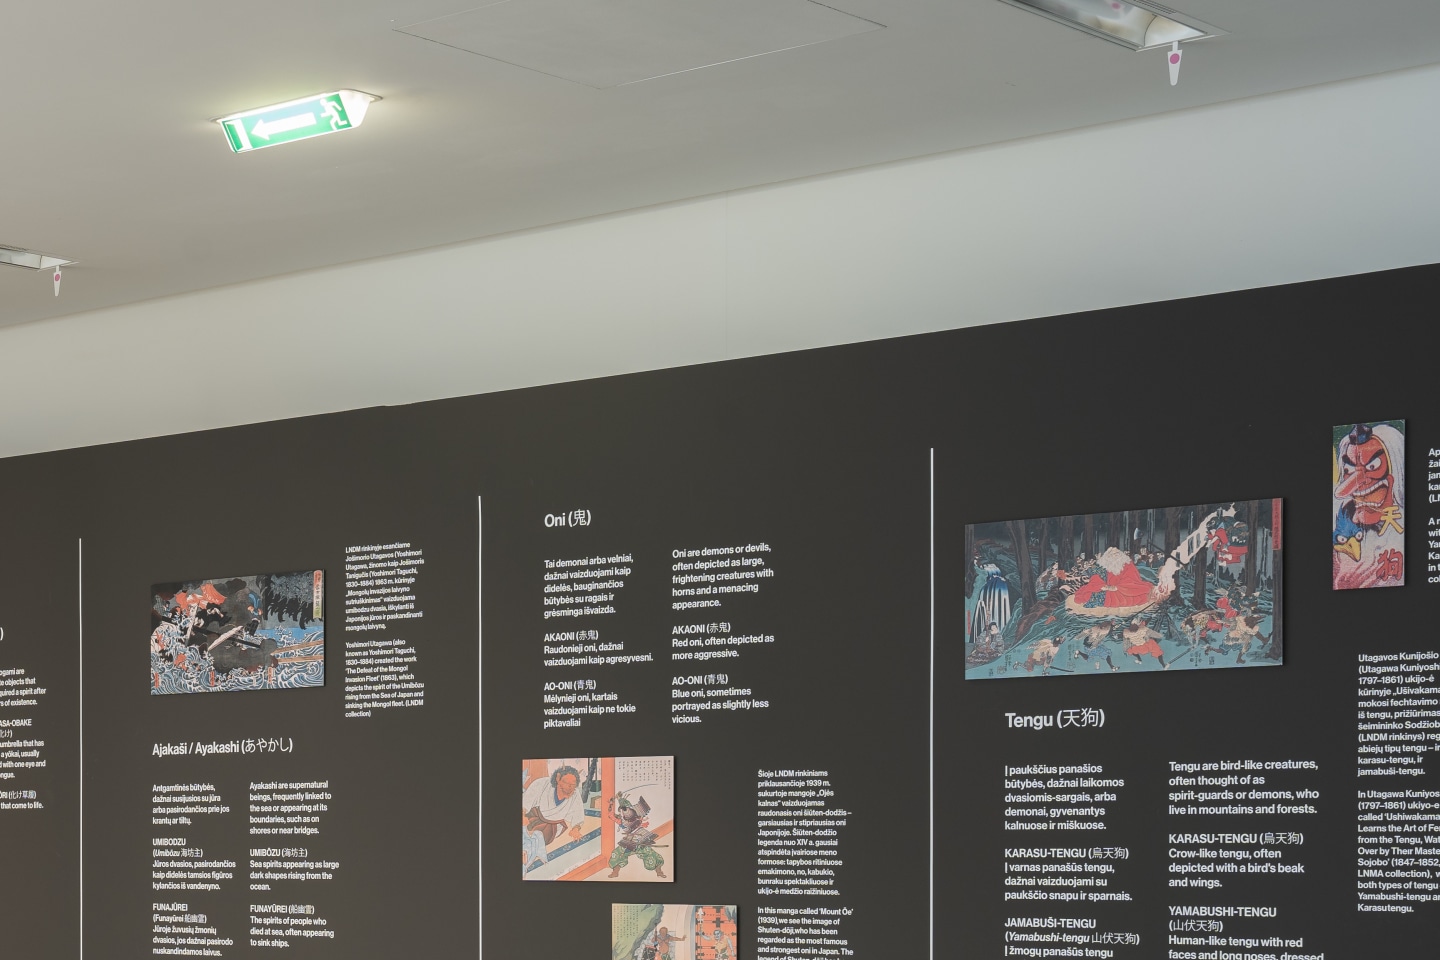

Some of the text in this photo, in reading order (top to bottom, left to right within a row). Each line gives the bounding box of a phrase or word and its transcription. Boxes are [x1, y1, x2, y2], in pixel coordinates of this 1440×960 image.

[544, 513, 565, 527] Oni
[672, 549, 686, 558] Oni
[701, 547, 734, 556] demons
[745, 542, 771, 552] devils,
[544, 553, 633, 568] Tai demonai arba velniai,
[672, 562, 693, 571] often
[694, 558, 730, 570] depicted
[742, 557, 764, 567] large,
[672, 568, 774, 586] frightening creatures with
[672, 600, 721, 610] appearance.
[672, 624, 705, 634] AKAONI
[544, 632, 575, 642] AKAONI
[544, 653, 653, 666] vaizduojami kaip agresyvesni.
[1358, 651, 1439, 663] Utagavos Kunijošio
[672, 676, 703, 685] AO-ONI
[1005, 713, 1053, 730] Tengu
[152, 742, 187, 757] Ajakaši
[195, 740, 239, 756] Ayakashi
[1009, 765, 1057, 776] paukščius
[1059, 764, 1102, 775] panašios
[1169, 760, 1318, 773] Tengu are bird-like creatures,
[250, 781, 277, 791] Ayakashi
[289, 780, 328, 790] supernatural
[1169, 776, 1196, 786] often
[1198, 775, 1238, 787] thought
[1240, 775, 1251, 784] of
[1169, 790, 1234, 802] spirit-guards
[1248, 789, 1294, 800] demons,
[1296, 789, 1319, 798] who
[1169, 804, 1317, 814] live in mountains and forests.
[1358, 801, 1440, 810] (1797–1861) ukiyo-e
[294, 826, 319, 835] bridges.
[1358, 824, 1427, 832] Learns the Art of
[1169, 833, 1257, 843] KARASU-TENGU
[1395, 835, 1422, 845] Tengu,
[250, 848, 281, 856] UMIBŌZU
[1005, 848, 1086, 858] KARASU-TENGU
[1169, 906, 1277, 917] YAMABUSHI-TENGU
[1358, 904, 1413, 913] Karasutengu.
[250, 916, 262, 924] The
[263, 916, 282, 925] spirits
[290, 917, 312, 926] people
[313, 917, 327, 925] who
[1005, 917, 1096, 928] JAMABUŠI-TENGU
[1005, 931, 1090, 944] (Yamabushi-tengu
[1169, 935, 1303, 948] Human-like tengu with red
[1168, 949, 1197, 959] faces
[1198, 950, 1218, 960] and
